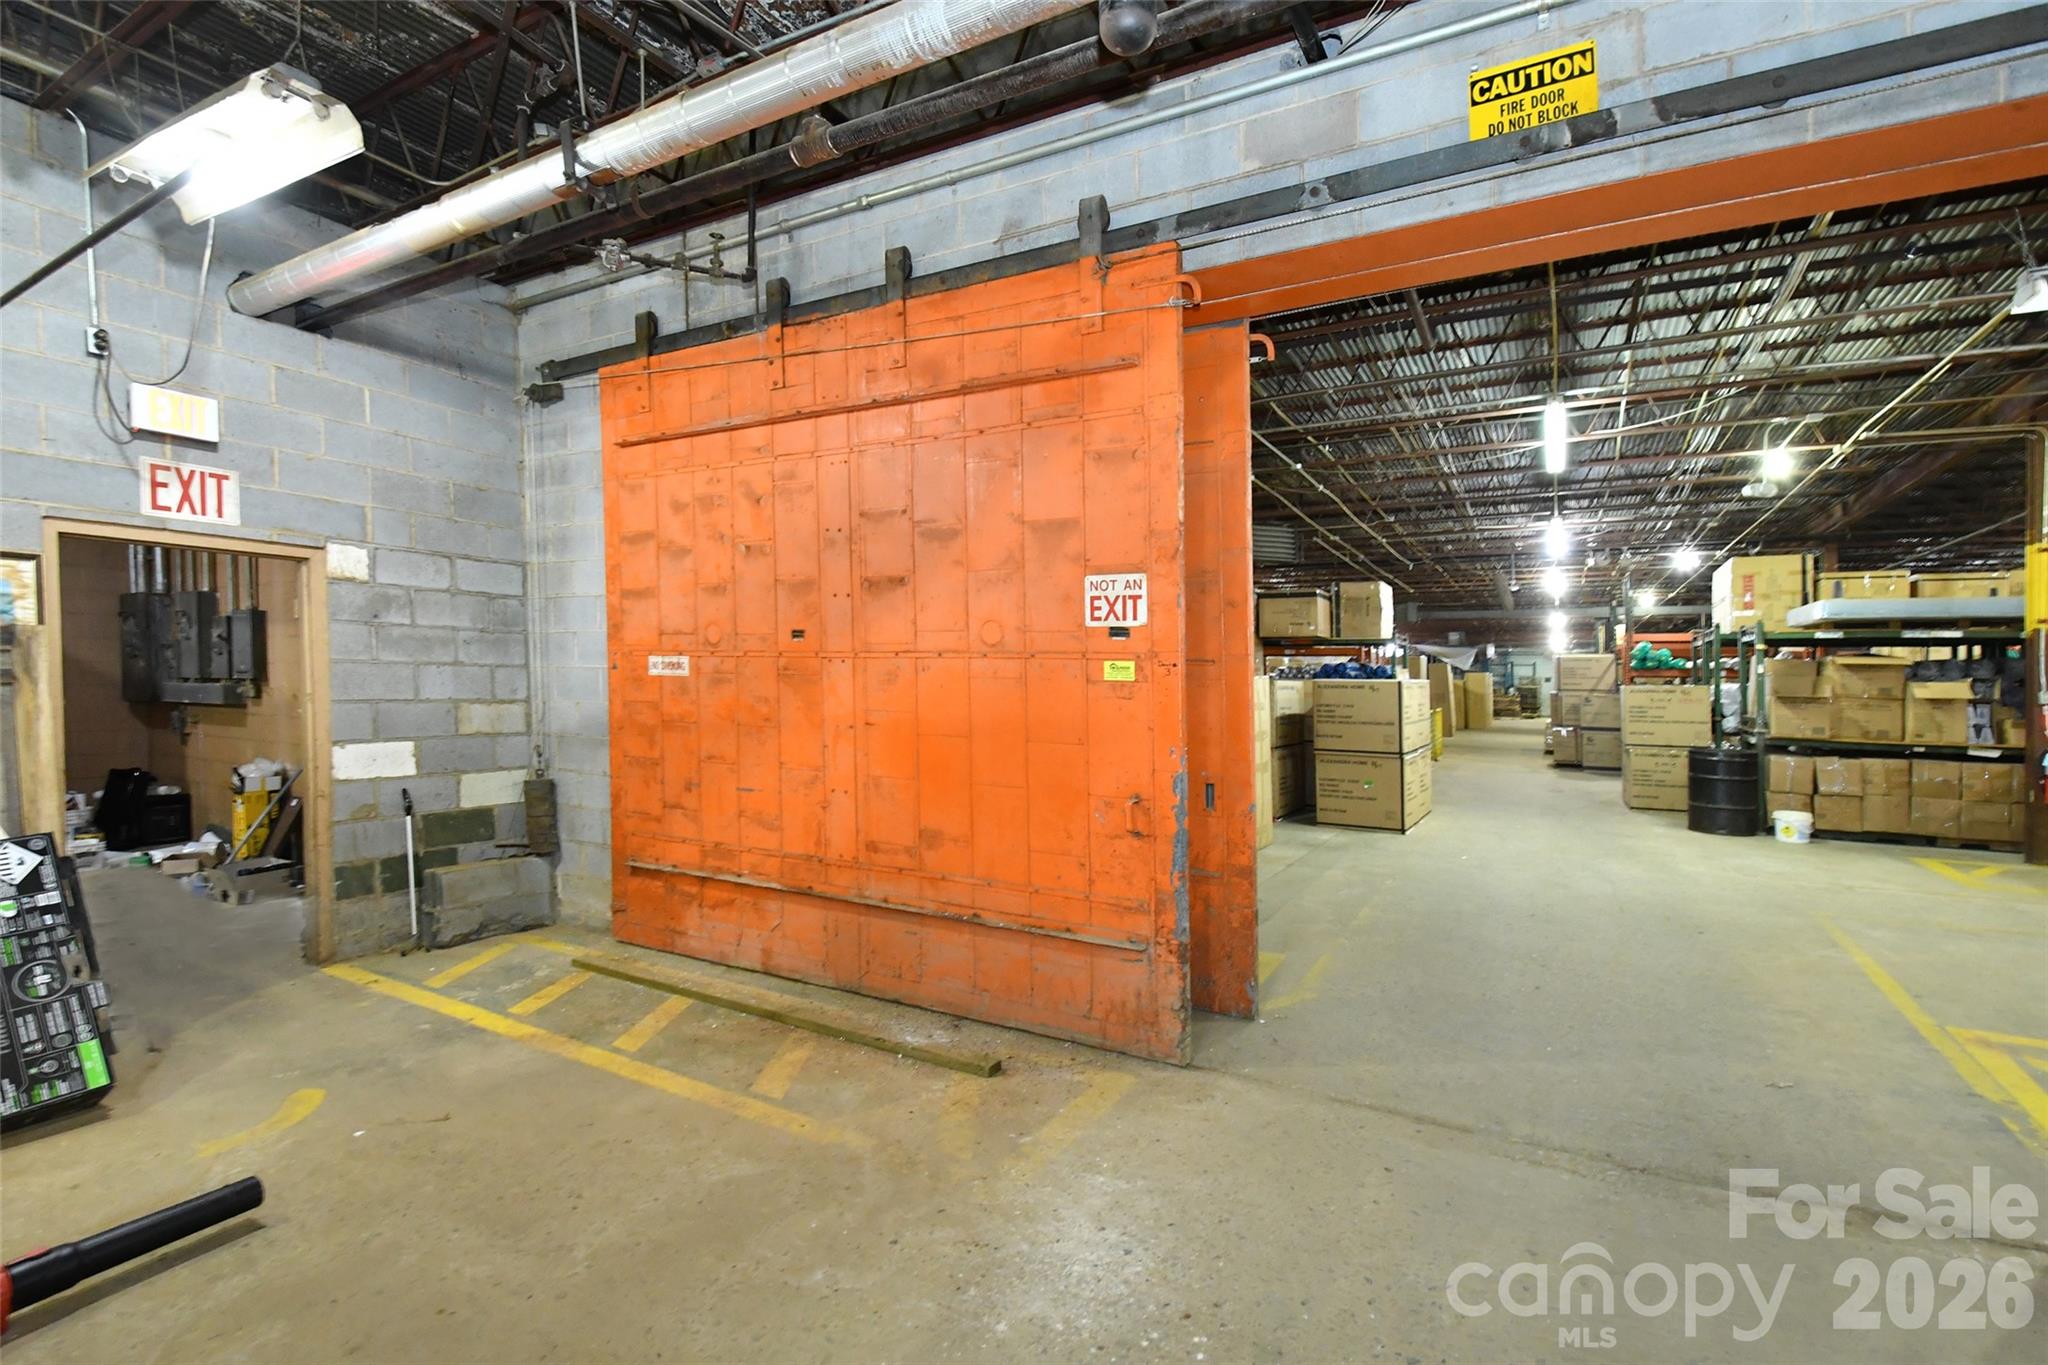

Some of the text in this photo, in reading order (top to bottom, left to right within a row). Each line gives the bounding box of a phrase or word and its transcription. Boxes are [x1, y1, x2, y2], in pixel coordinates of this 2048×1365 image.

[1471, 51, 1593, 104] CAUTION
[1488, 101, 1580, 137] DO NOT BLOCK
[1500, 88, 1565, 117] FIRE DOOR
[149, 390, 209, 432] EXIT
[150, 463, 230, 519] EXIT
[1090, 579, 1143, 592] NOT AN
[1090, 595, 1143, 621] EXIT
